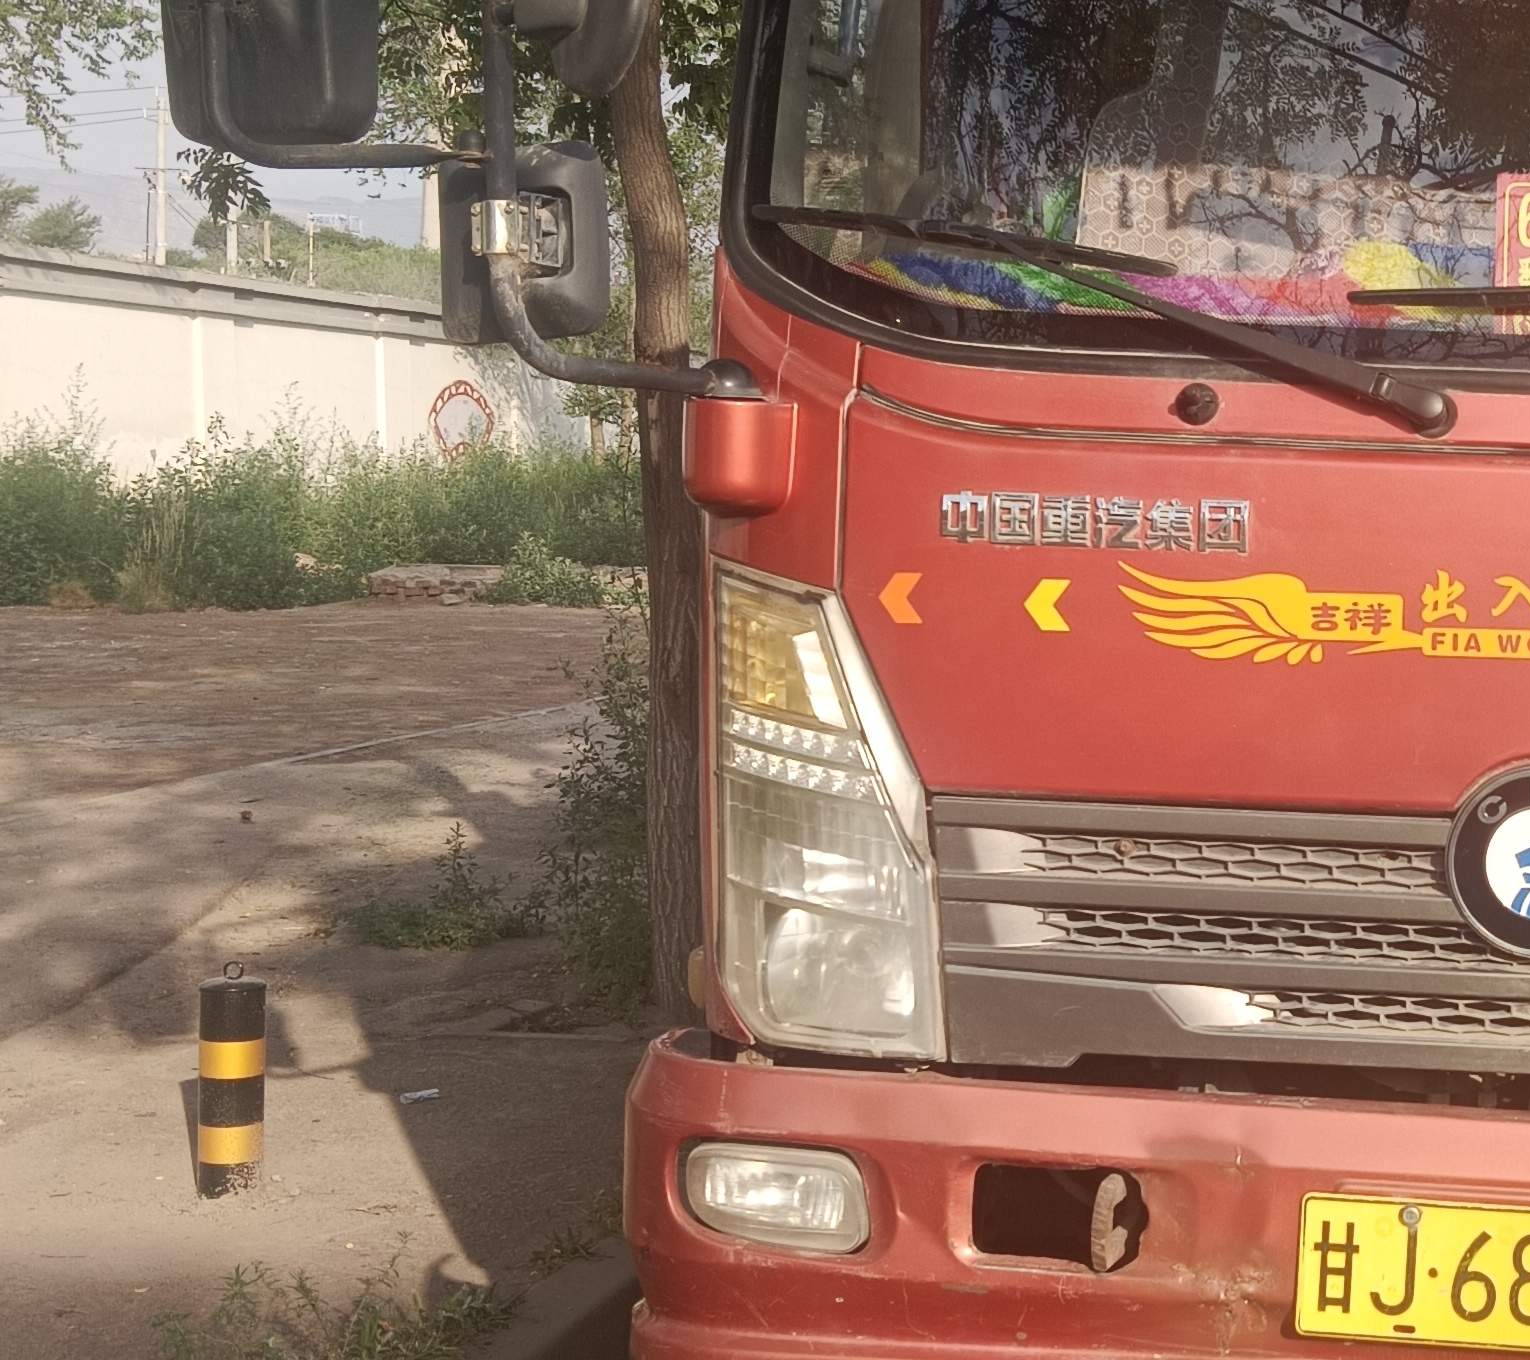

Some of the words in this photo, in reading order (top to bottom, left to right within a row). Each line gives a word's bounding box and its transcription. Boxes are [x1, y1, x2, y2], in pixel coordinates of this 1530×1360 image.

[941, 490, 1251, 556] 中国重汽集团
[1311, 602, 1392, 635] 吉祥
[1431, 631, 1481, 652] FIA
